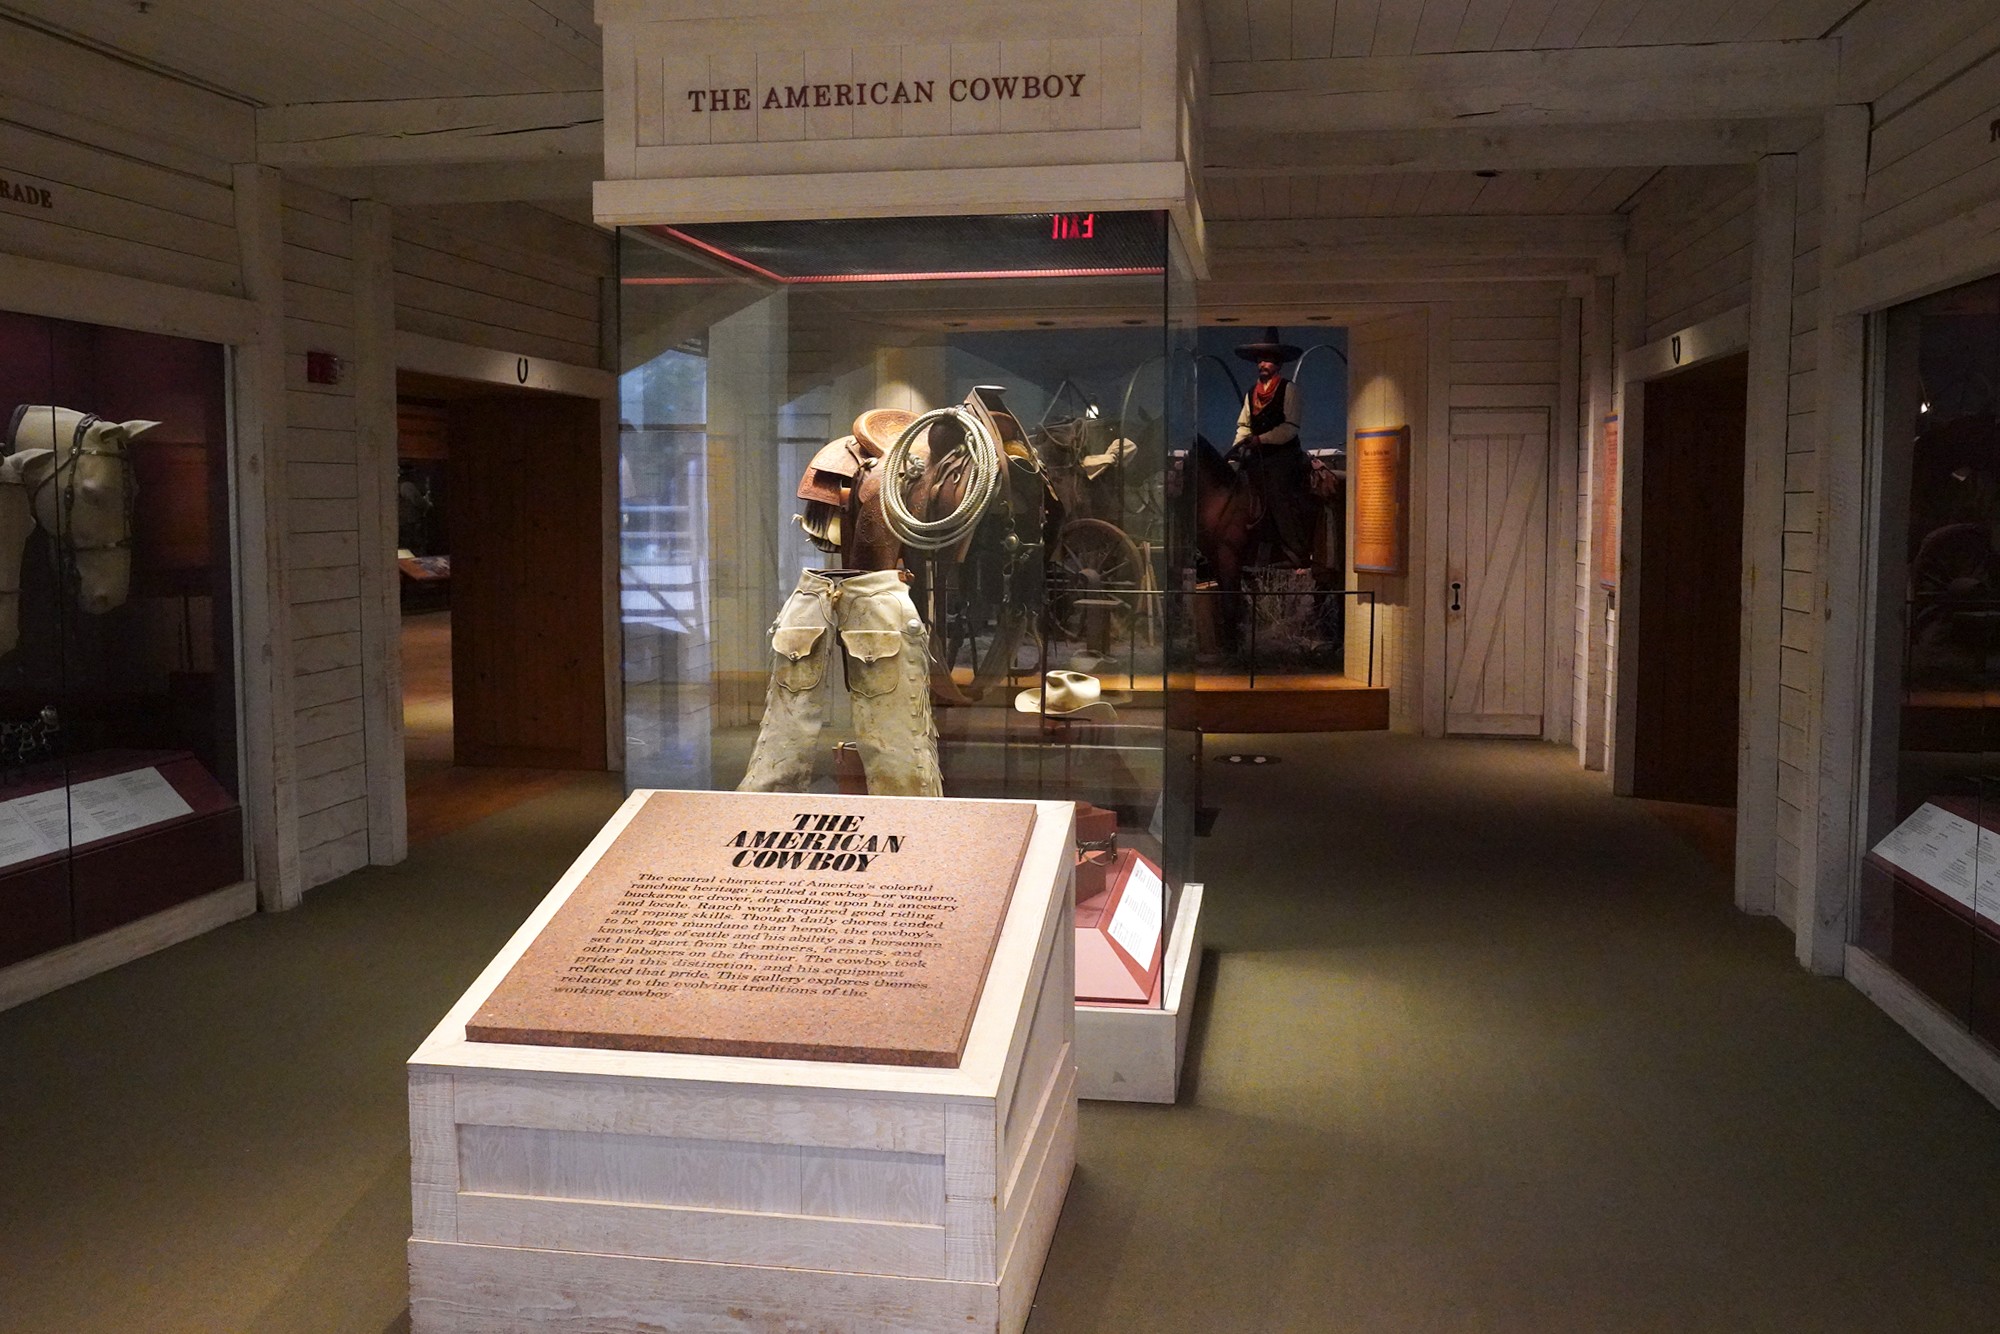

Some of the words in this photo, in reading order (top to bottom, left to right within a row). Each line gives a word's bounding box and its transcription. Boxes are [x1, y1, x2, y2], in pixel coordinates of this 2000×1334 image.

[688, 89, 751, 112] THE
[763, 81, 935, 109] AMERICAN
[949, 74, 1085, 102] COWBOY
[792, 813, 865, 832] THE
[725, 830, 905, 853] AMERICAN
[732, 850, 878, 872] COWBOY
[631, 883, 690, 892] ranching
[693, 884, 748, 894] heritage
[766, 887, 806, 896] called
[900, 894, 957, 903] vaquero,
[639, 873, 663, 882] The
[668, 876, 716, 884] central
[719, 878, 785, 886] character
[806, 880, 876, 889] America's
[880, 884, 934, 892] colorful
[617, 899, 644, 907] and
[648, 900, 690, 909] locale.
[697, 902, 741, 911] Ranch
[747, 904, 782, 913] work
[786, 907, 847, 916] required
[851, 910, 886, 918] good
[890, 911, 936, 920] riding
[624, 891, 685, 900] buckaroo
[706, 894, 753, 902] drover,
[757, 896, 831, 906] depending
[898, 903, 959, 912] ancestry
[611, 908, 638, 916] and
[642, 911, 689, 919] roping
[691, 912, 734, 920] skills.
[741, 913, 795, 923] Though
[801, 916, 837, 925] daily
[841, 918, 888, 927] chores
[893, 920, 943, 929] tended
[597, 927, 671, 937] knowledge
[690, 931, 730, 939] cattle
[733, 932, 760, 941] and
[763, 933, 785, 941] his
[788, 935, 835, 944] ability
[871, 939, 944, 948] horseman
[682, 921, 749, 930] mundane
[753, 924, 790, 932] than
[791, 925, 839, 935] heroic,
[843, 927, 868, 935] the
[871, 929, 934, 939] cowboy's
[583, 946, 623, 954] other
[626, 947, 685, 957] laborers
[711, 951, 735, 960] the
[739, 952, 798, 962] frontier.
[805, 955, 833, 964] The
[836, 957, 891, 968] cowboy
[894, 960, 928, 969] took
[615, 937, 644, 945] him
[648, 939, 688, 948] apart
[693, 940, 727, 948] from
[733, 942, 756, 950] the
[760, 944, 818, 953] miners,
[823, 946, 887, 956] farmers,
[893, 950, 922, 958] and
[568, 965, 633, 975] reflected
[635, 968, 666, 977] that
[668, 969, 711, 979] pride.
[716, 971, 748, 981] This
[751, 974, 805, 985] gallery
[807, 977, 870, 987] explores
[574, 955, 616, 964] pride
[619, 957, 635, 965] in
[639, 958, 668, 966] this
[672, 959, 757, 971] distinction,
[763, 964, 791, 973] and
[797, 965, 821, 974] his
[824, 968, 905, 978] equipment
[553, 986, 615, 997] working
[617, 989, 675, 999] cowboy.
[560, 975, 623, 987] relating
[625, 978, 641, 986] to
[645, 978, 671, 988] the
[673, 980, 739, 992] evolving
[741, 984, 818, 995] traditions
[822, 987, 841, 996] of
[841, 988, 868, 998] the
